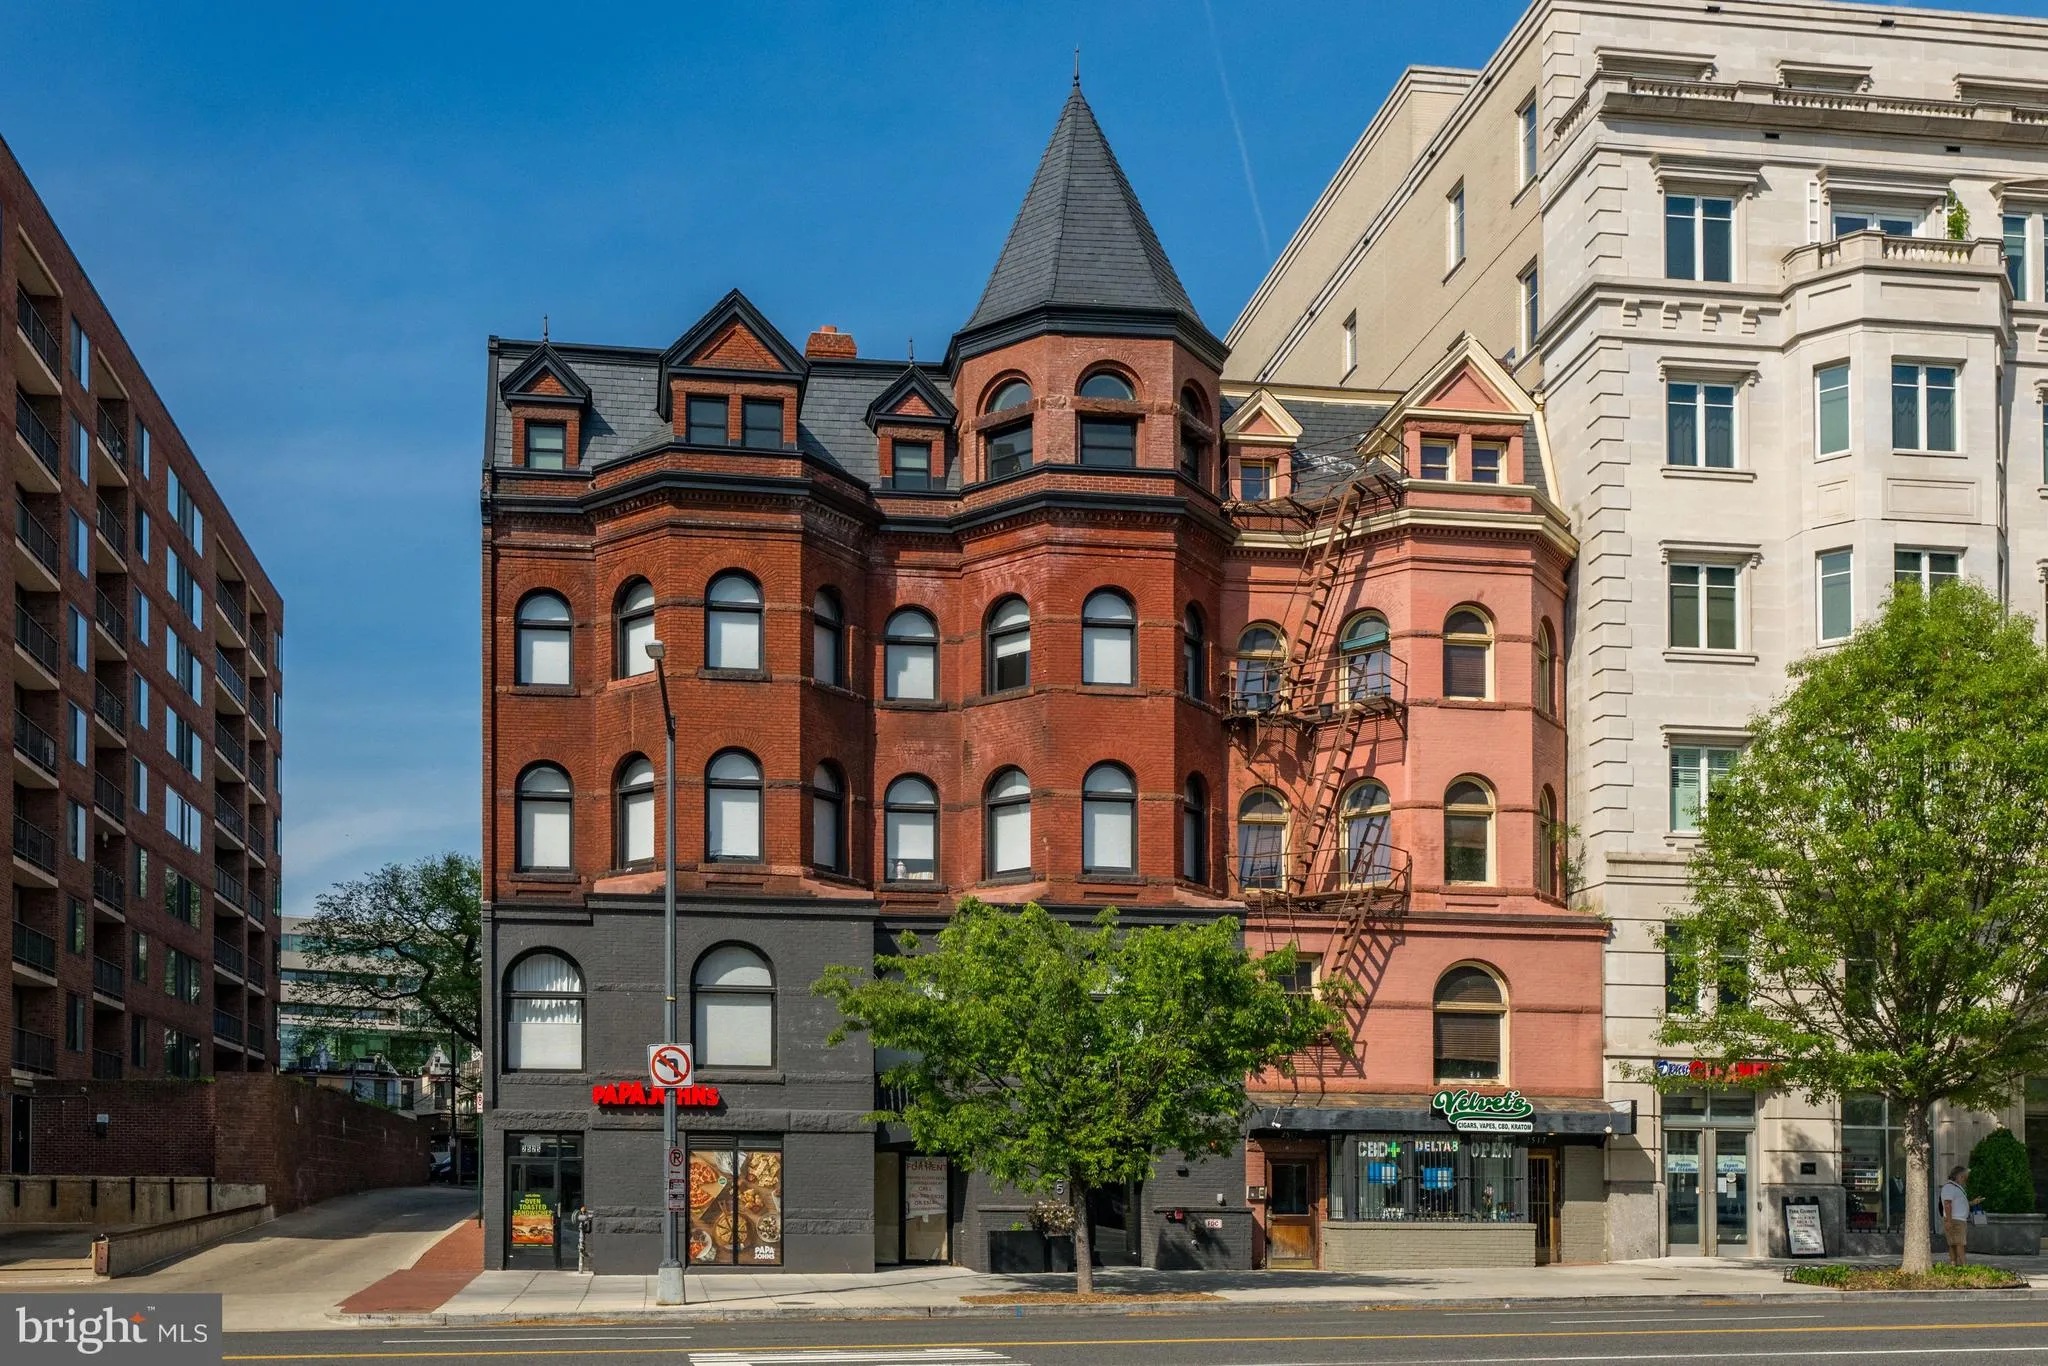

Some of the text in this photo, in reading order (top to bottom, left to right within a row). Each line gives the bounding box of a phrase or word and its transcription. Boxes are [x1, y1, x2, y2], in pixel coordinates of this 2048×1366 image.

[592, 1081, 719, 1106] PAPA JHNS
[1433, 1090, 1531, 1116] Velvet's
[1458, 1122, 1478, 1130] CIGARS,
[1480, 1122, 1496, 1130] VAPES,
[1511, 1123, 1532, 1131] KRATOM
[1471, 1142, 1512, 1158] OPEN
[754, 1246, 775, 1254] PAPA
